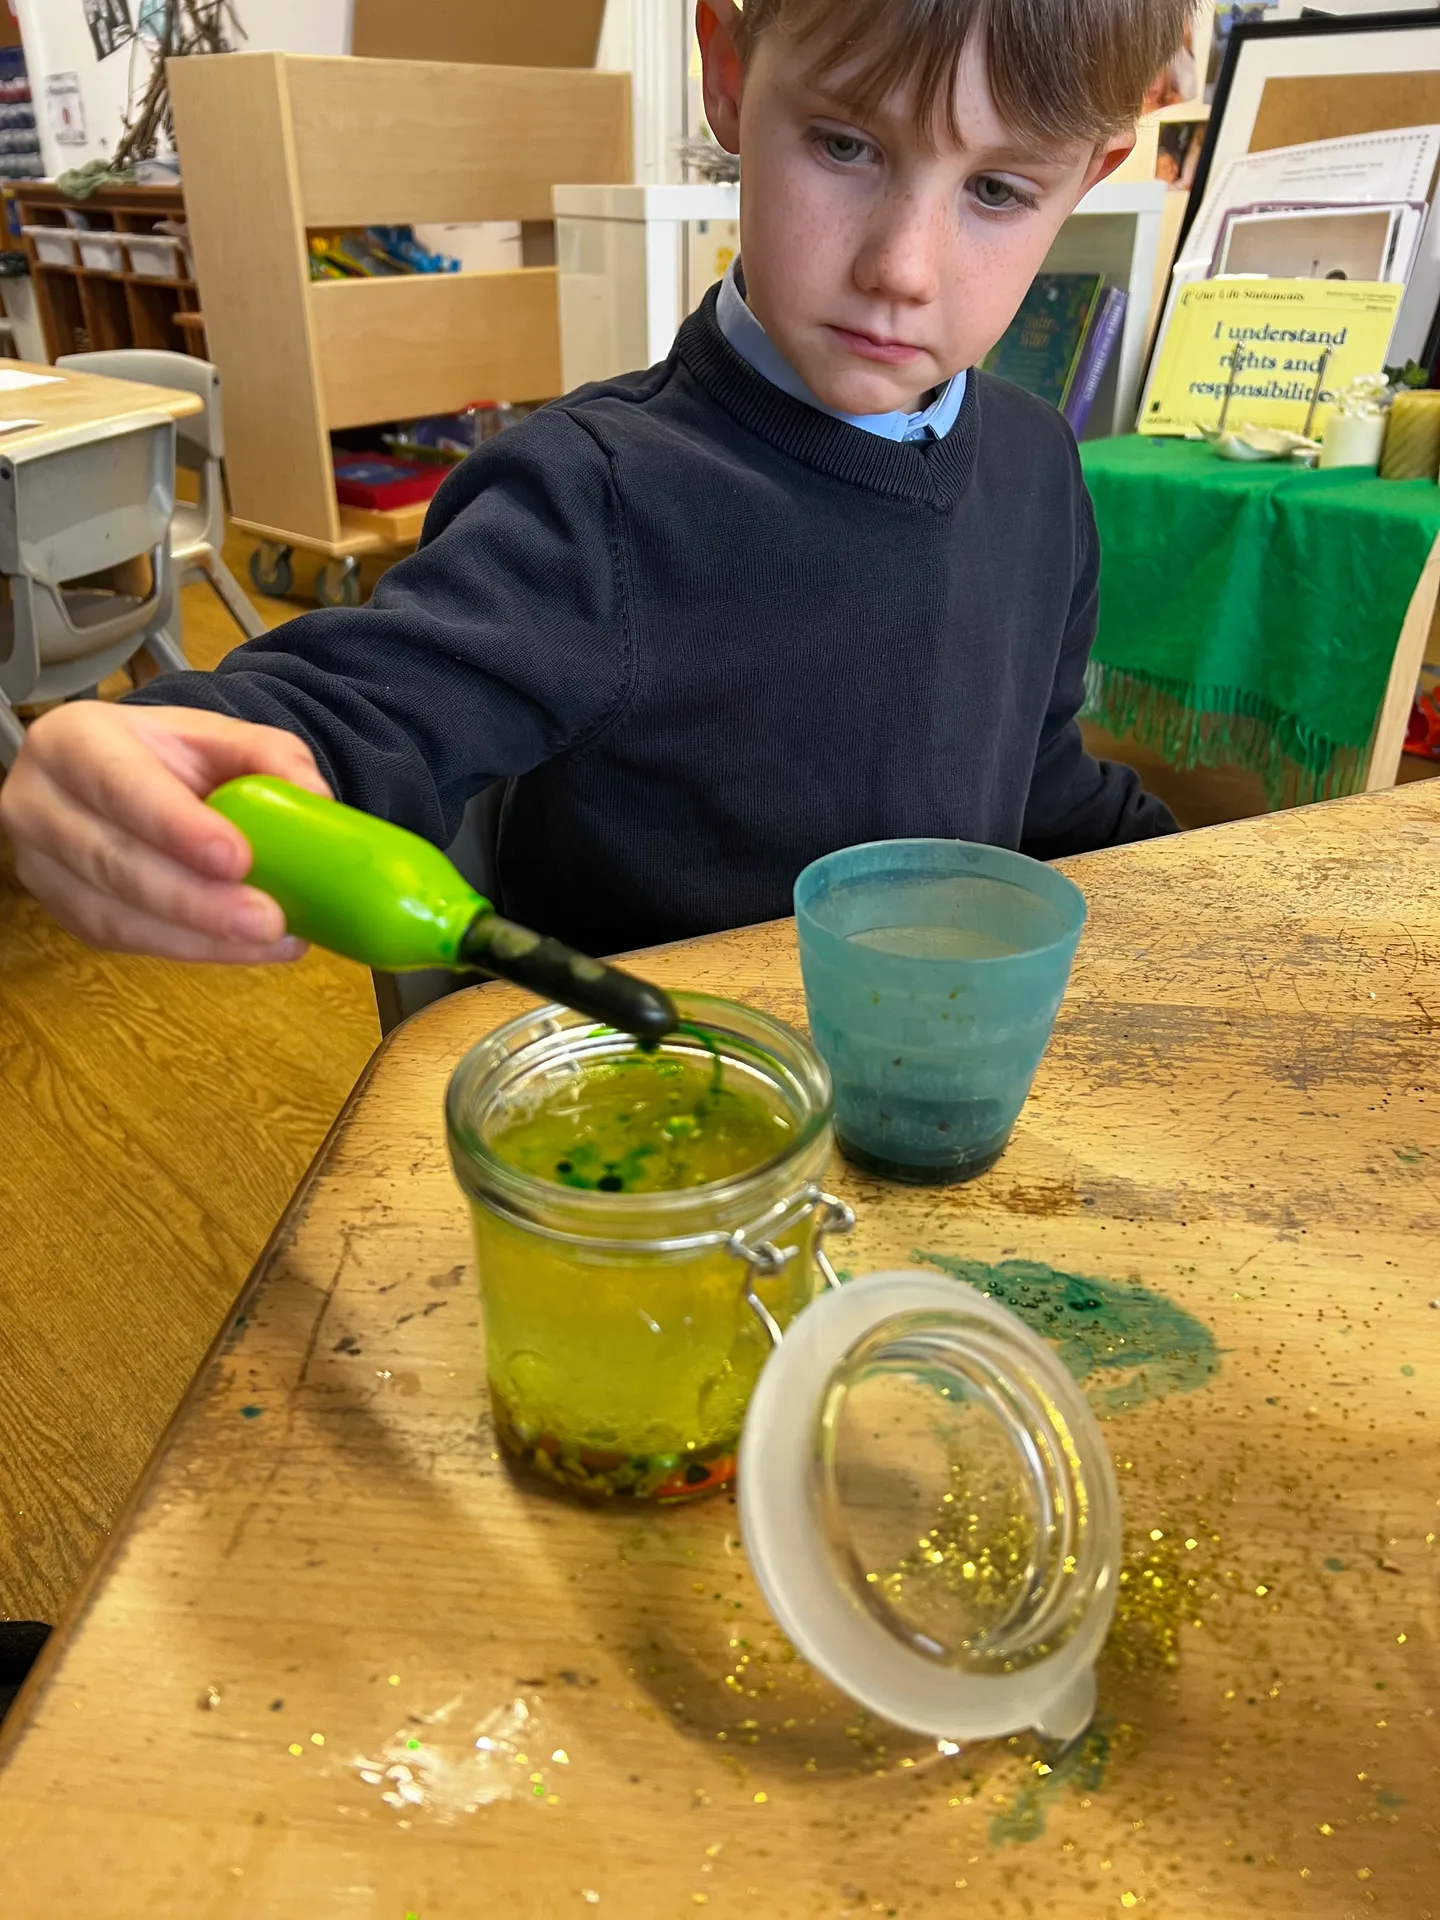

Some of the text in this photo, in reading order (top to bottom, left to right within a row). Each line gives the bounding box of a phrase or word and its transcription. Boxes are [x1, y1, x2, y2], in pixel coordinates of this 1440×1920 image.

[1214, 320, 1348, 345] I understand
[1220, 350, 1325, 373] rights and
